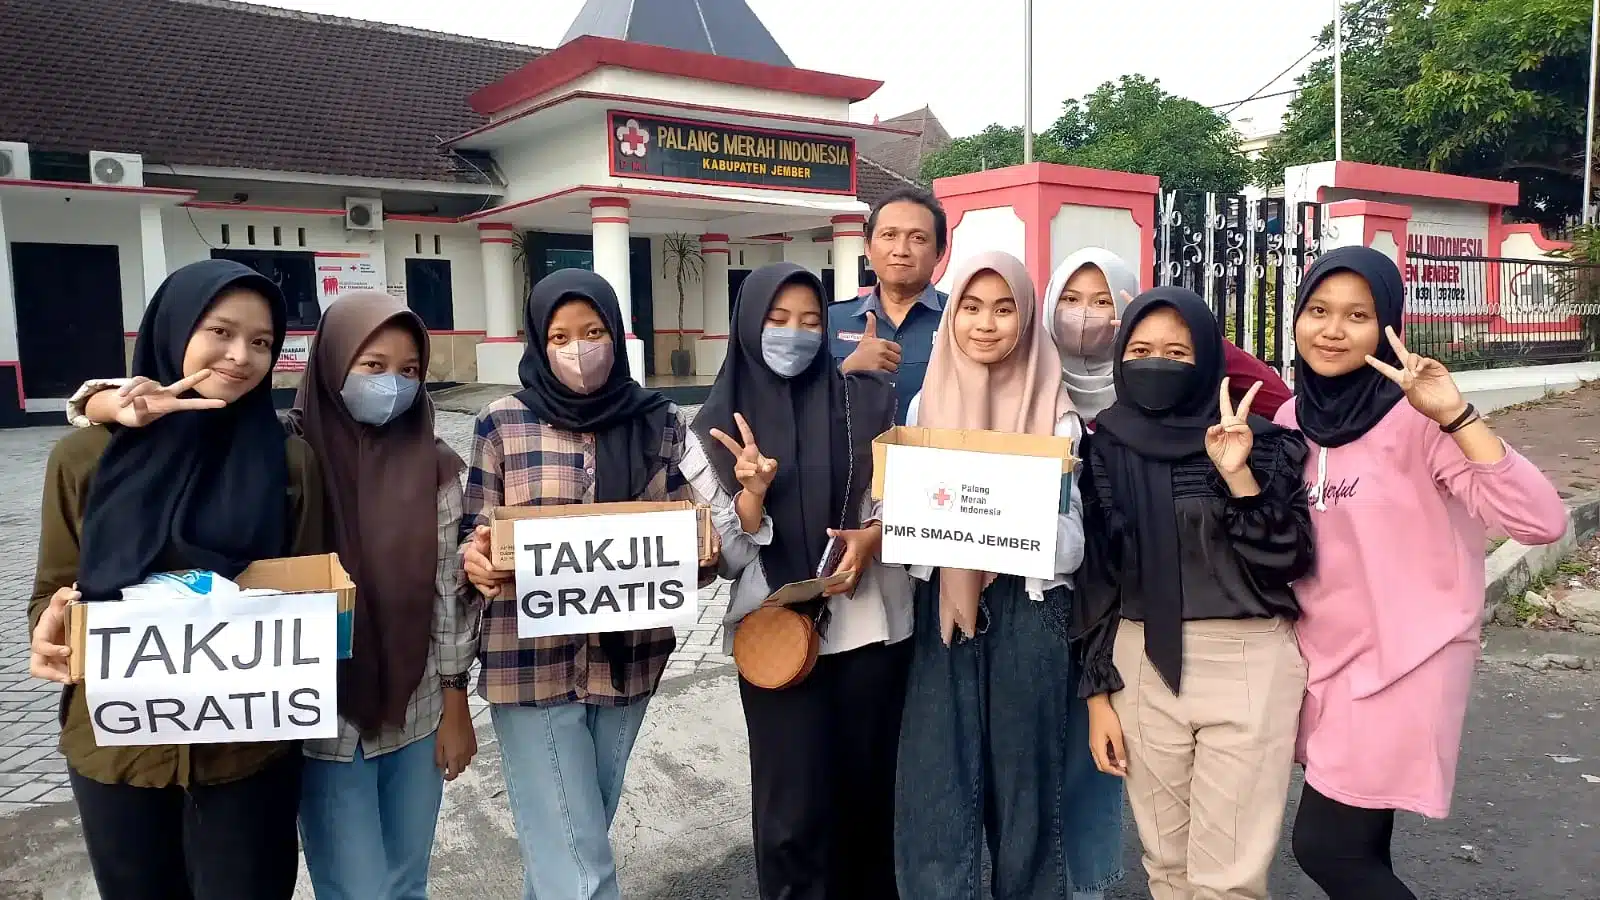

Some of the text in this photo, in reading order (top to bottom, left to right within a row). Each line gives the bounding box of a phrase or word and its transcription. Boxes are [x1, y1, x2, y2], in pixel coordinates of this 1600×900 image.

[657, 125, 850, 166] PALANG MERAH INDONESIA
[702, 158, 811, 179] KABUPATEN JEMBER
[1427, 235, 1483, 257] INDONESIA
[1421, 265, 1460, 284] JEMBER
[961, 483, 990, 495] Palang
[961, 494, 987, 505] Merah
[960, 505, 1001, 516] Indonesia
[884, 524, 1041, 552] PMR SMADA JEMBER
[523, 535, 680, 577] TAKJIL
[521, 579, 685, 619] GRATIS
[89, 618, 320, 680] TAKJIL
[94, 687, 321, 735] GRATIS
